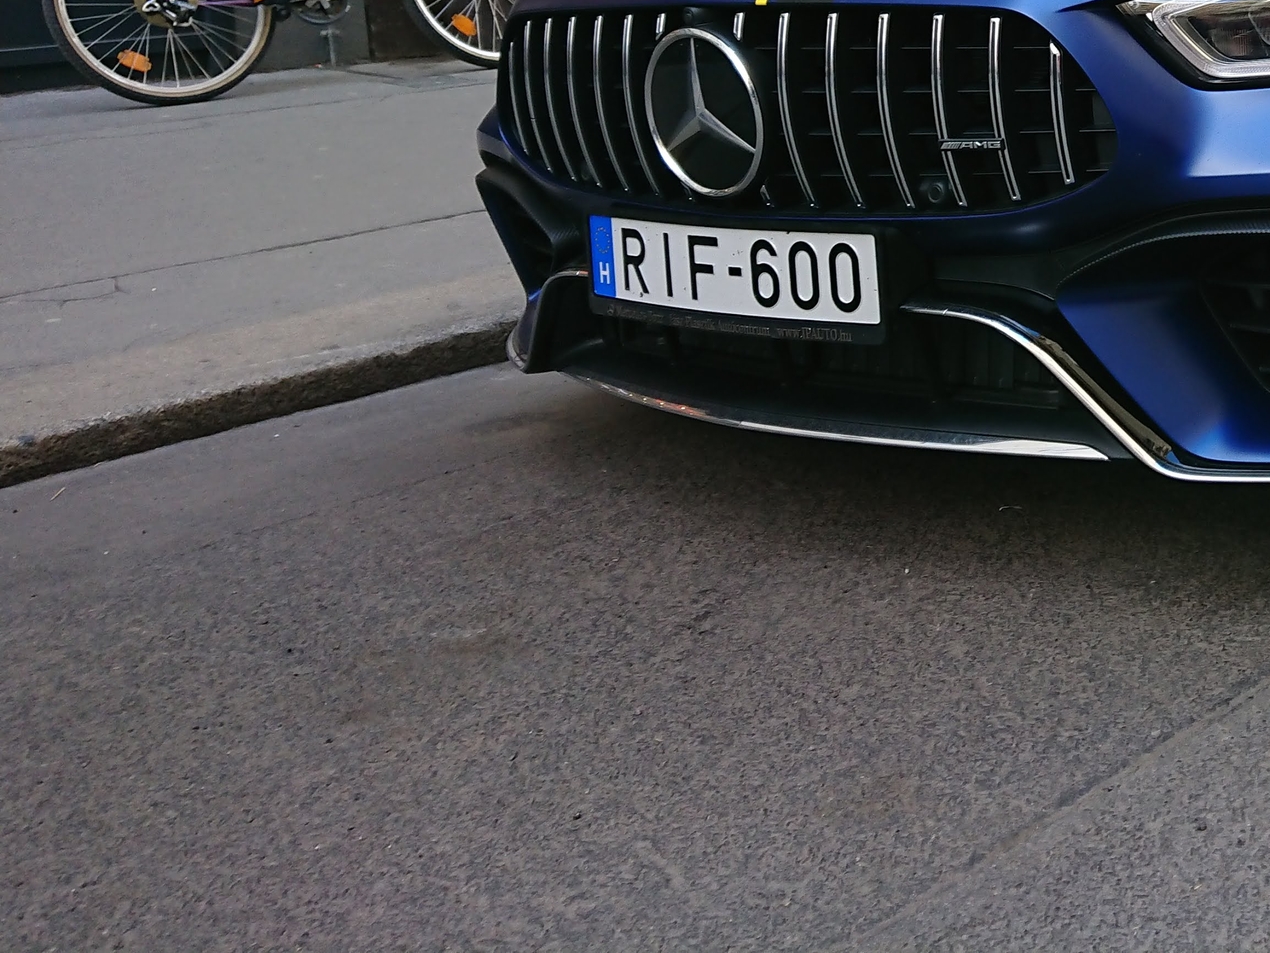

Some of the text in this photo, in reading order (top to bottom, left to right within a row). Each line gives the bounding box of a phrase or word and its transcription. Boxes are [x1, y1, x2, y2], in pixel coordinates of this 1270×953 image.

[959, 140, 1001, 149] AMG
[599, 227, 862, 313] H RIF-600
